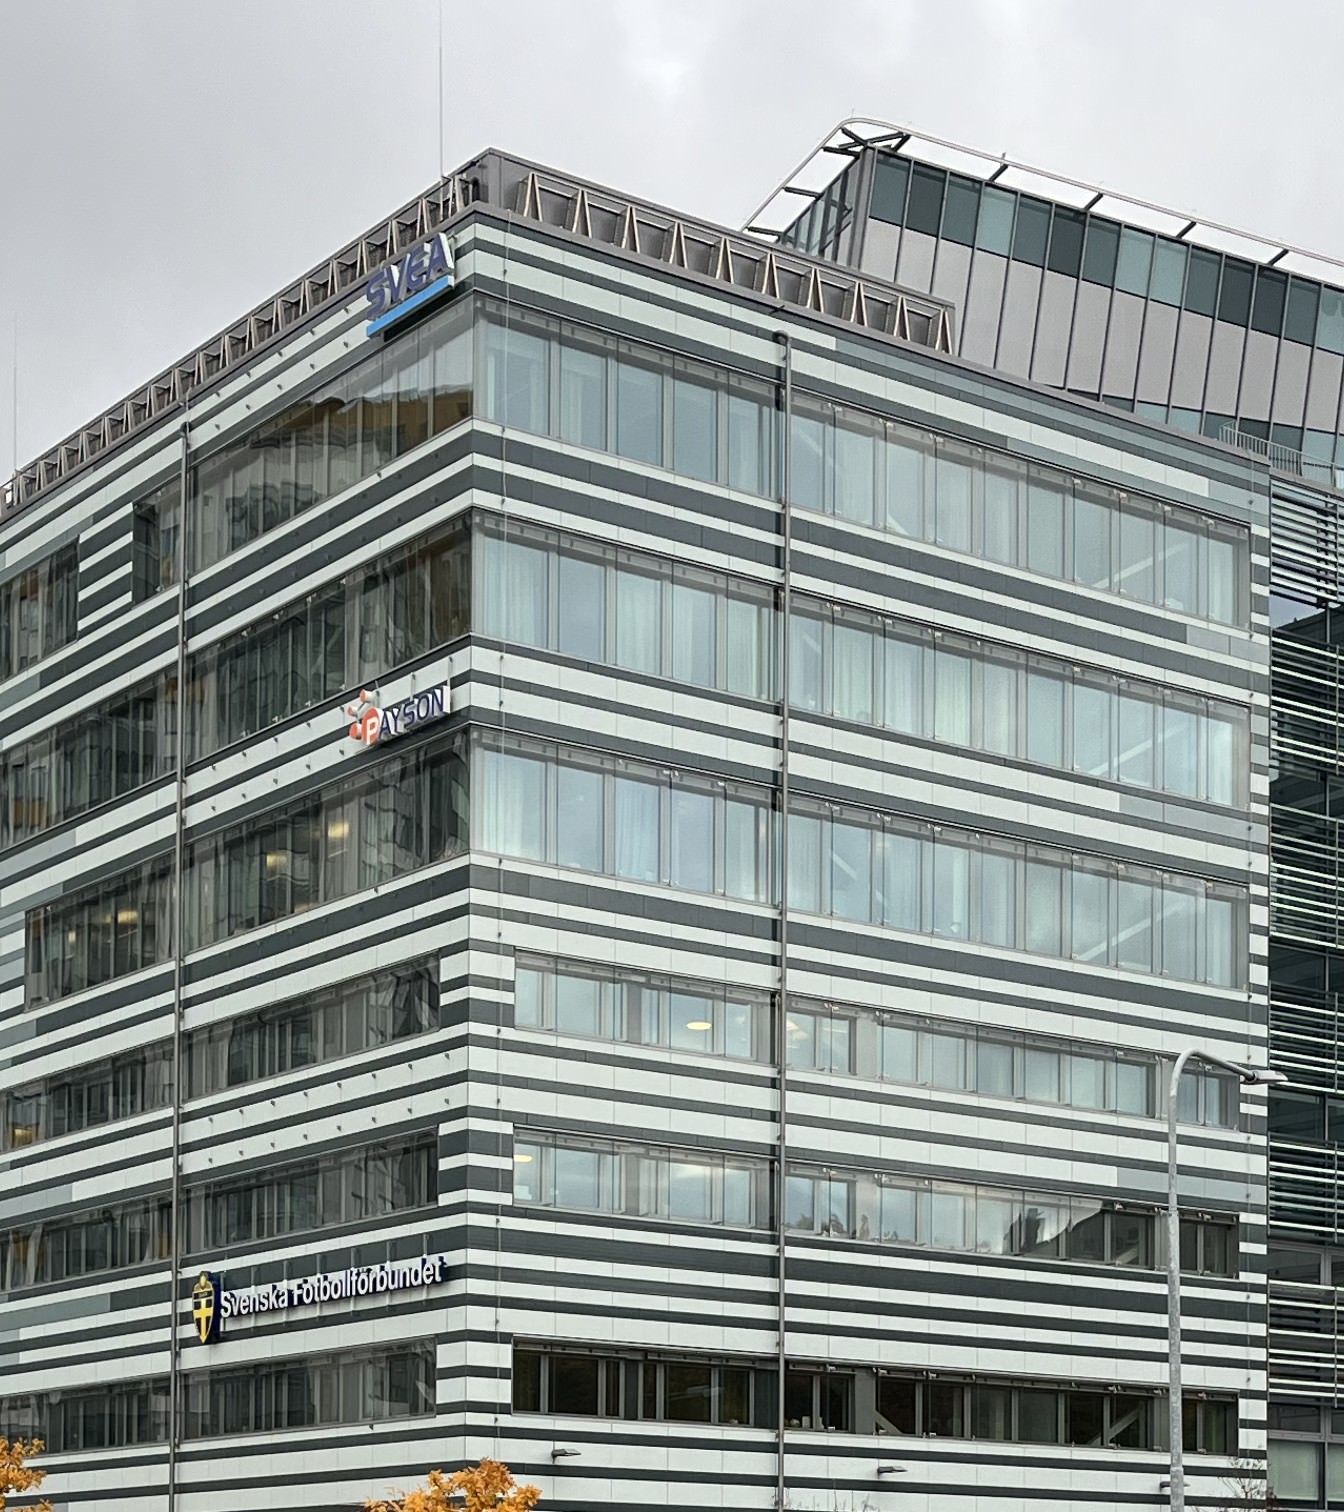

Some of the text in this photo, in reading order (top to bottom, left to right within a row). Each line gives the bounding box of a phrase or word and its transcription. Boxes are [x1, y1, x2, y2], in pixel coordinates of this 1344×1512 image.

[366, 232, 454, 320] SVEA
[366, 685, 450, 745] PAYSON
[220, 1255, 444, 1318] Svenska Fotbollförbundet
